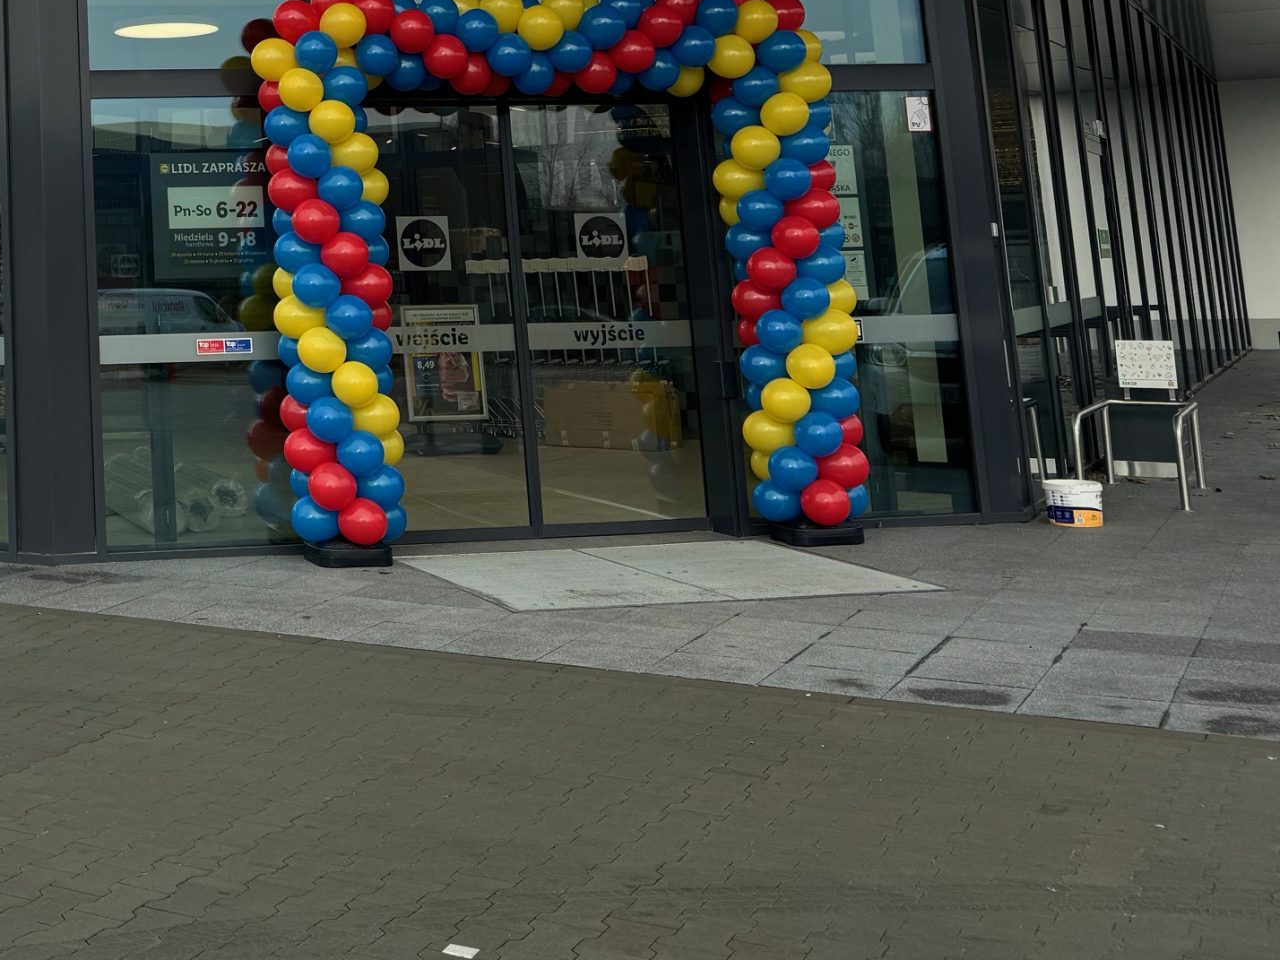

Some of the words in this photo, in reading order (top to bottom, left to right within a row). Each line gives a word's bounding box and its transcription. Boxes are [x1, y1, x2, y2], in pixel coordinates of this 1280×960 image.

[171, 162, 199, 174] LIDL
[202, 161, 266, 173] ZAPRASZA
[173, 204, 212, 218] Pn-So
[216, 201, 259, 218] 6-22
[174, 233, 214, 242] Niedziela
[218, 231, 257, 247] 9-18
[573, 324, 646, 346] wyjście
[416, 360, 435, 370] 8,49
